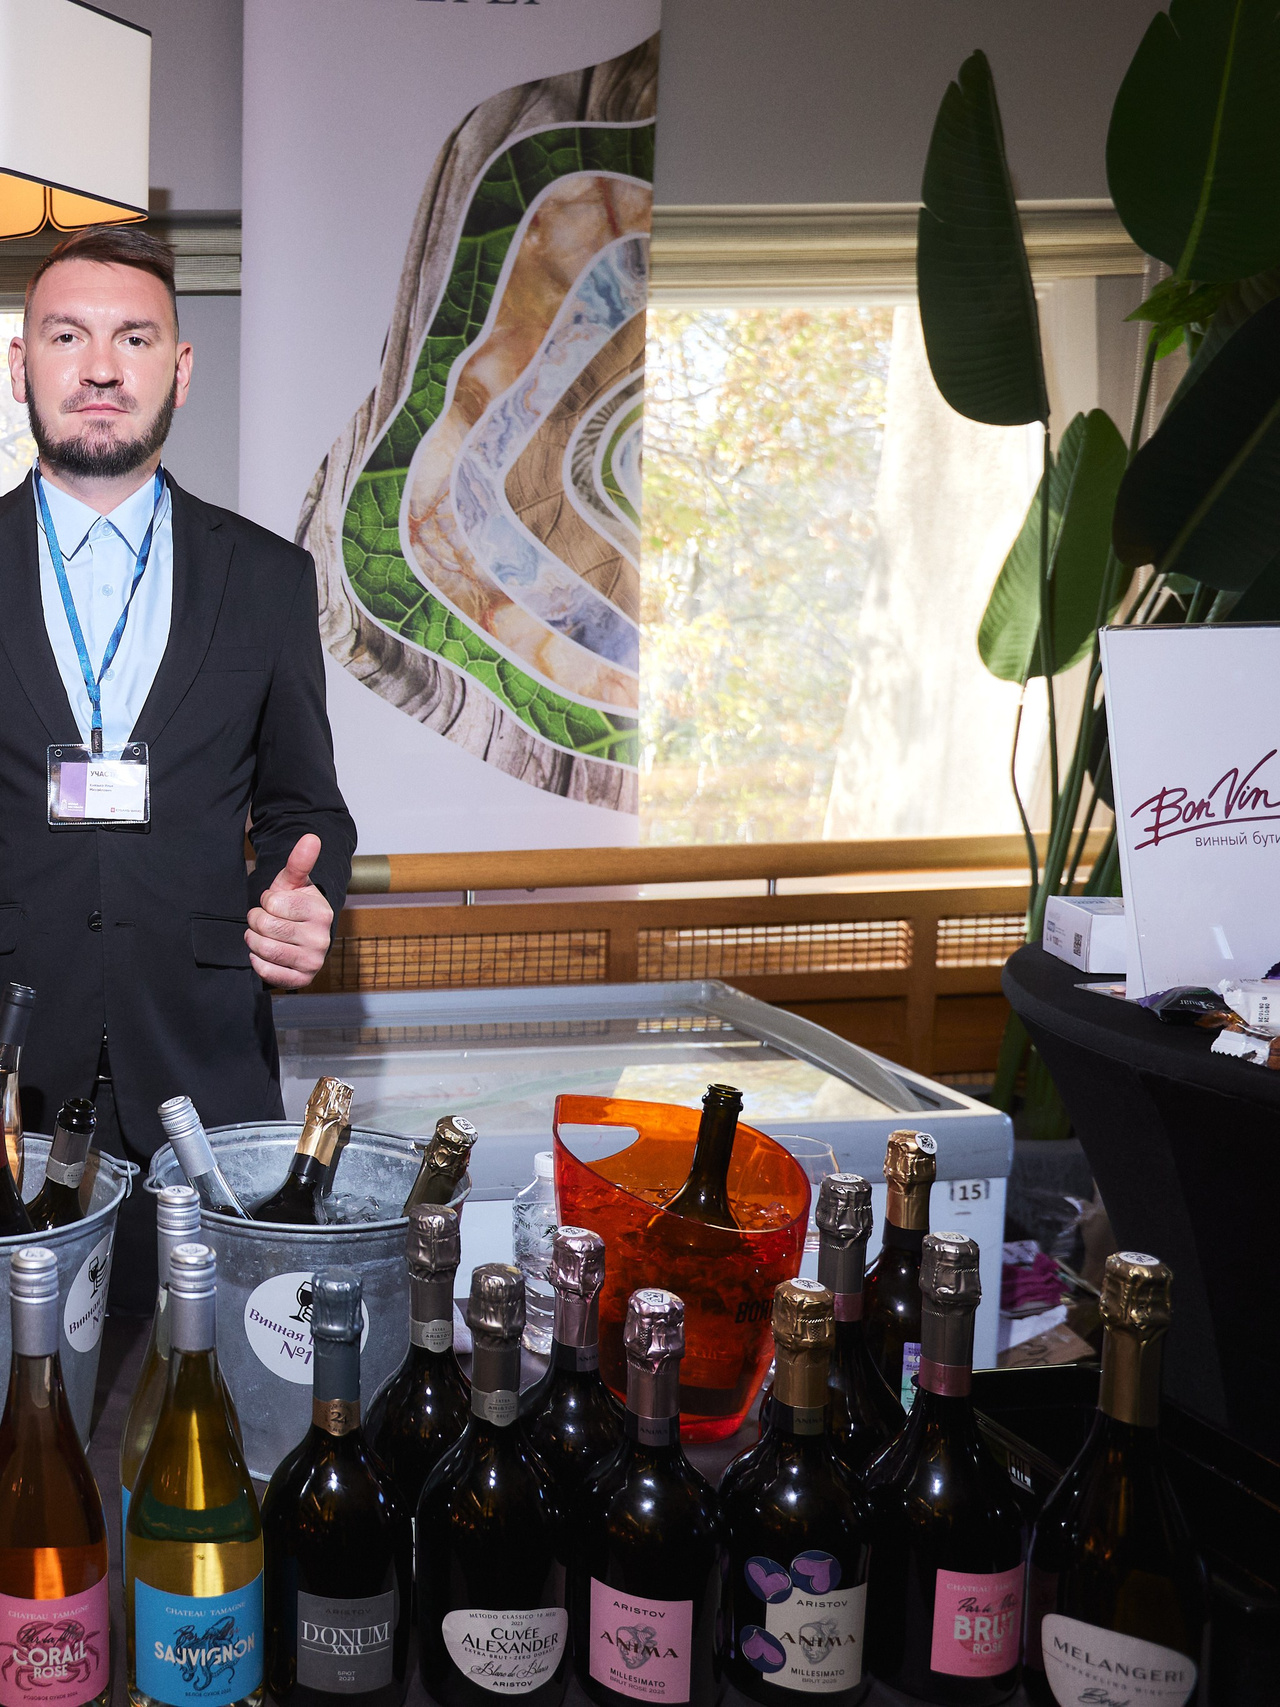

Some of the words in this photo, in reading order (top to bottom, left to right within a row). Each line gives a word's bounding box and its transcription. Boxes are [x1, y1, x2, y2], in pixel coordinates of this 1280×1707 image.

[1130, 786, 1216, 847] Bon
[1208, 749, 1280, 820] Vin
[1195, 831, 1248, 847] винный
[1252, 830, 1280, 848] бути
[958, 1183, 982, 1202] 15
[248, 1307, 306, 1343] Винная
[279, 1339, 313, 1366] №1
[8, 1609, 49, 1620] CHATEAU
[53, 1603, 90, 1620] TAMAGNE
[165, 1606, 207, 1618] CHATEAU
[210, 1601, 246, 1616] TAMAGNE
[613, 1600, 666, 1619] ARISTOV
[796, 1599, 848, 1609] ARISTOV
[300, 1620, 391, 1647] DONUM
[490, 1626, 540, 1641] CUVÉE
[953, 1609, 1016, 1642] BRUT
[461, 1632, 559, 1655] ALEXANDER
[600, 1630, 679, 1659] ANIMA
[779, 1631, 857, 1648] ANIMA
[12, 1640, 88, 1667] CORAIL
[154, 1632, 256, 1667] SAUVIGNON
[330, 1644, 365, 1656] XXIV
[464, 1647, 486, 1657] EXTRA
[609, 1667, 666, 1688] MILLESIMATO
[609, 1675, 627, 1687] BRUT
[790, 1667, 845, 1678] MILLESIMATO
[492, 1680, 533, 1688] ARISTOV
